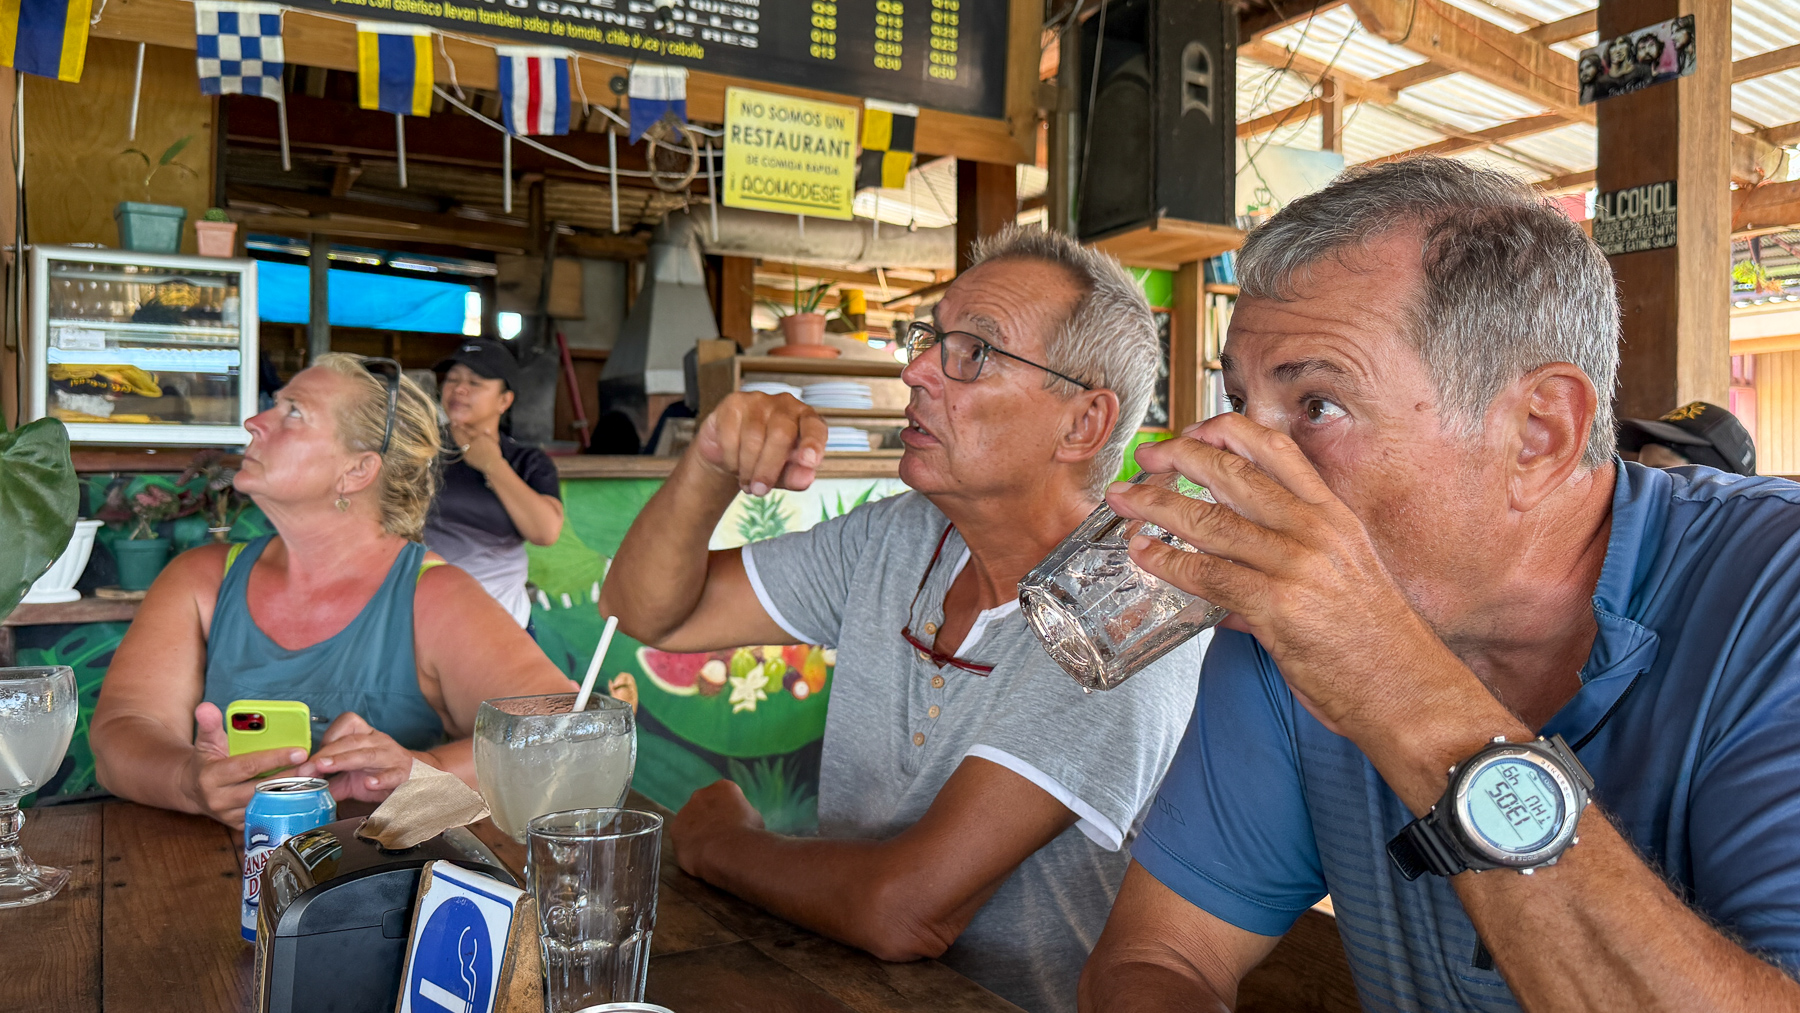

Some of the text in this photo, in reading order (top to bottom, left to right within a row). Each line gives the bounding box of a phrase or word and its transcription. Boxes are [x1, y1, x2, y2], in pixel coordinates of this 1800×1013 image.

[443, 2, 477, 22] llevan
[551, 19, 566, 37] de
[689, 0, 760, 20] QUESO
[875, 13, 903, 28] Q15
[931, 9, 959, 26] Q15
[537, 0, 648, 29] CARNE
[701, 27, 760, 48] RES
[875, 25, 903, 42] Q15
[809, 43, 836, 60] Q15
[740, 102, 846, 130] NO SOMOS UN
[730, 124, 852, 158] RESTAURANT
[745, 154, 759, 165] DE
[741, 175, 842, 204] ACOMODESE
[1502, 766, 1520, 786] 49
[1488, 781, 1532, 827] 13:05
[1524, 795, 1552, 825] THU
[244, 849, 275, 875] ANA
